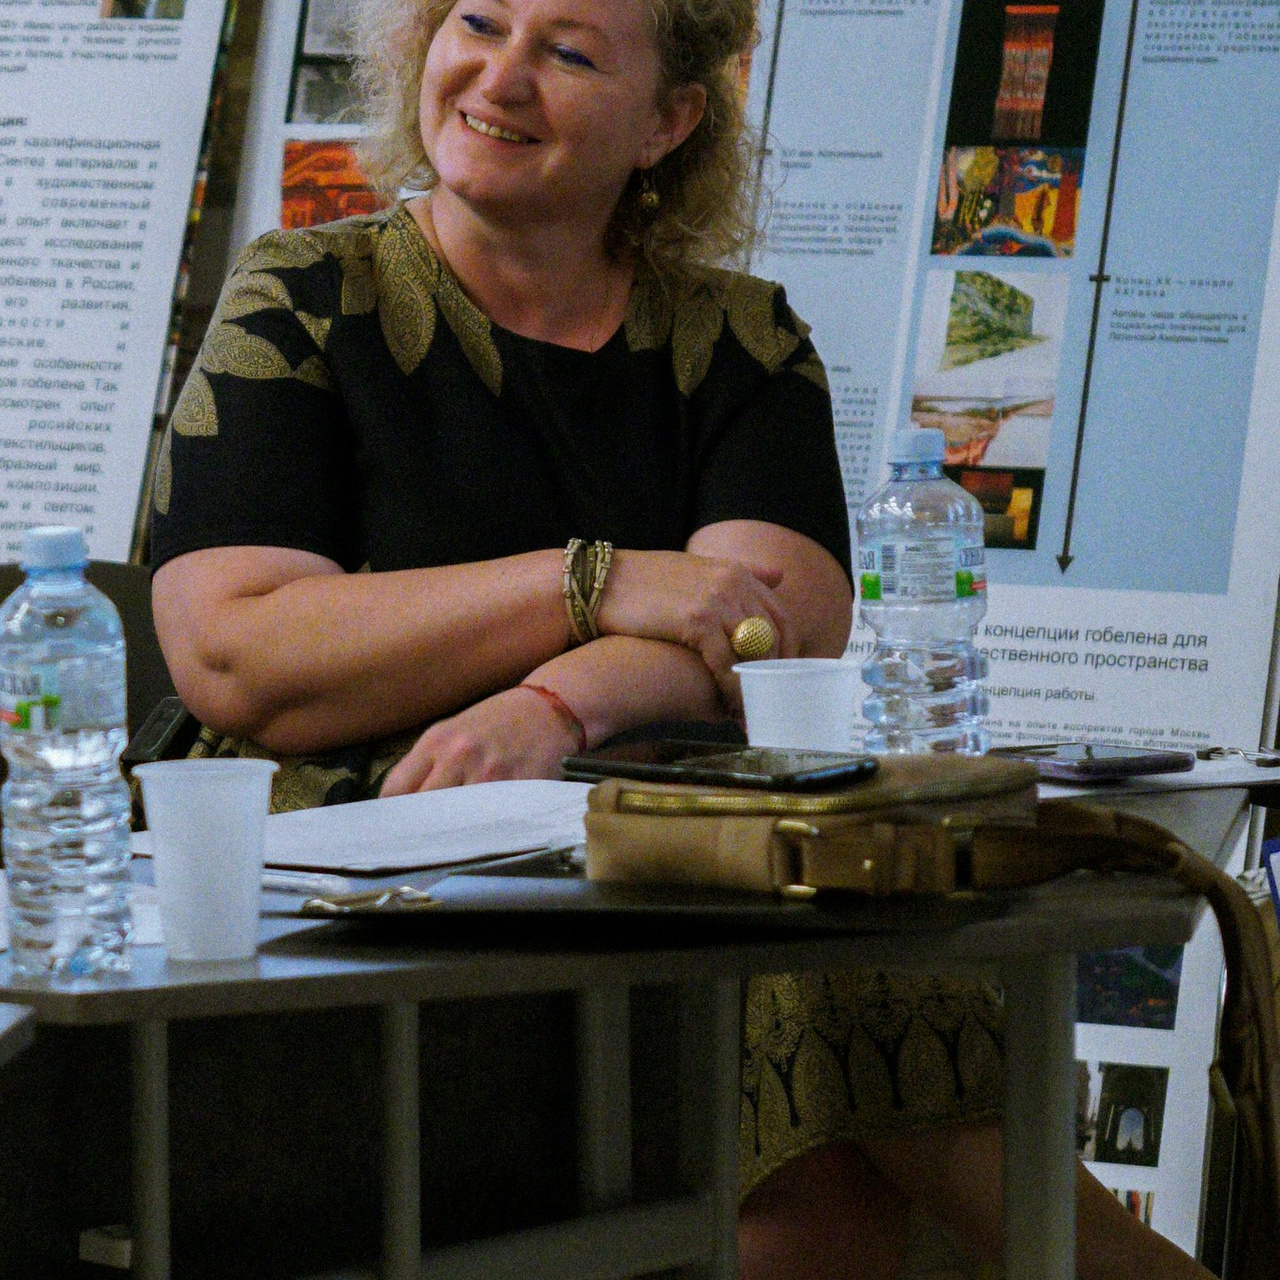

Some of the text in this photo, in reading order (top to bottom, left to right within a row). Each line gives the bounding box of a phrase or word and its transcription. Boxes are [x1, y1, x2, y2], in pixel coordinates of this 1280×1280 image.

[24, 137, 161, 150] квалификационная
[985, 623, 1207, 647] концепции гобелена для
[981, 647, 1209, 671] ественного пространства
